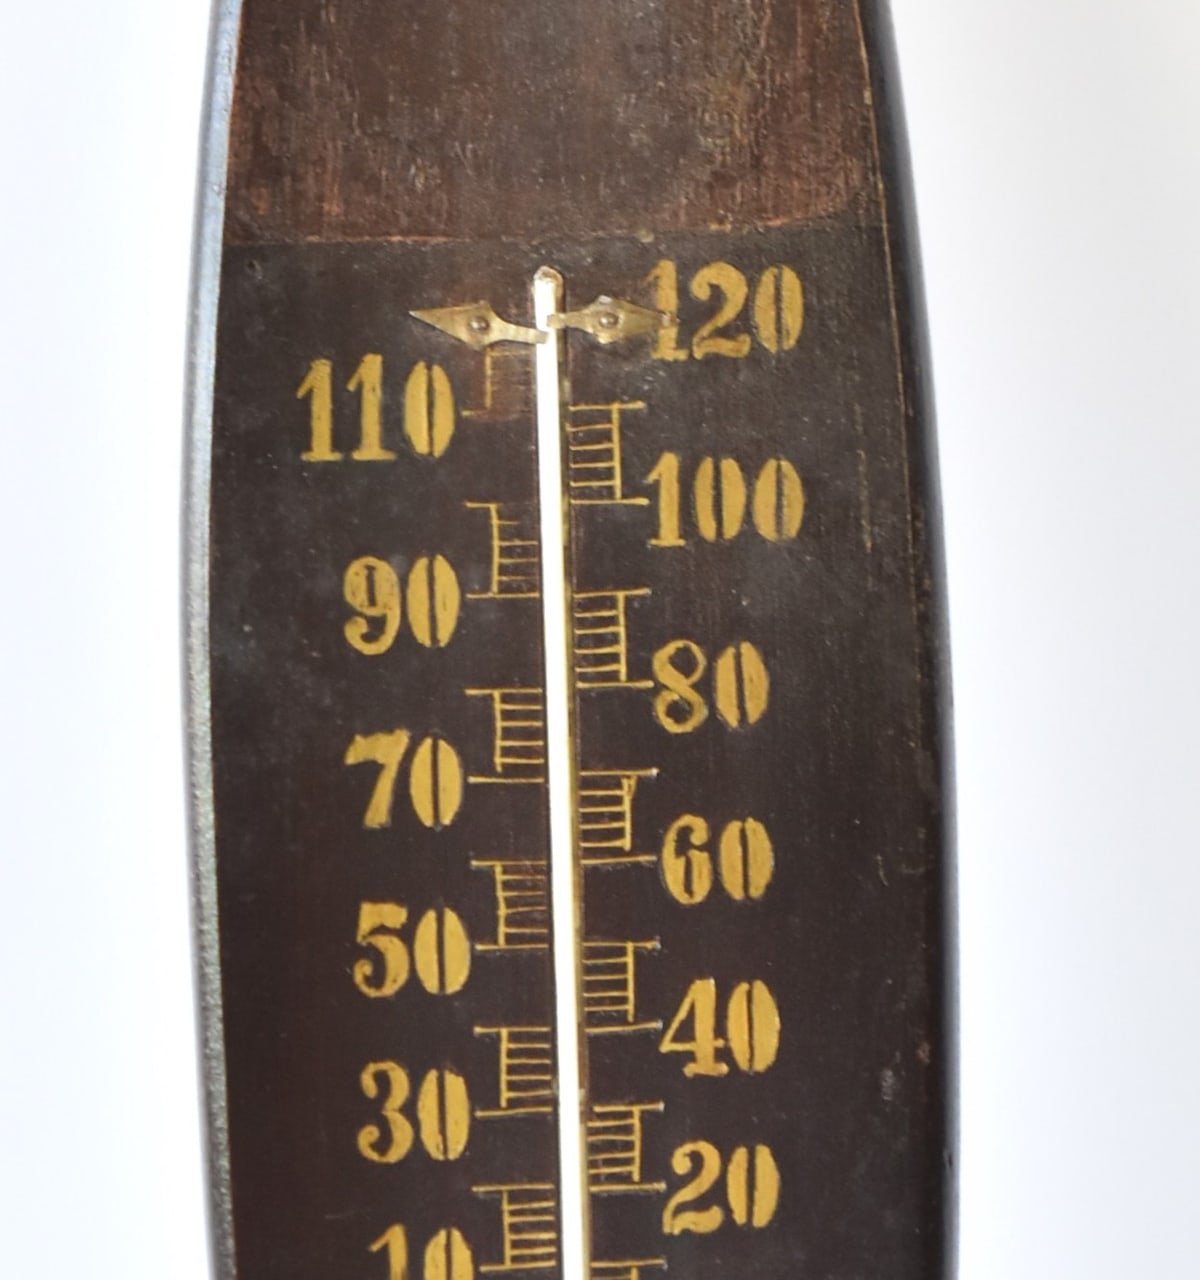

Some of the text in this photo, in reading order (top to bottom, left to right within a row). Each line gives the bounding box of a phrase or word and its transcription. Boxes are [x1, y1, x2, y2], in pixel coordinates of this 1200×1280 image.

[646, 259, 803, 362] 120
[296, 353, 457, 462] 110
[645, 451, 804, 548] 100
[343, 553, 460, 655] 90
[652, 639, 770, 734] 80
[344, 728, 462, 828] 70
[661, 813, 774, 905] 60
[352, 901, 471, 998] 50
[659, 977, 781, 1077] 40
[356, 1060, 471, 1163] 30
[661, 1140, 781, 1235] 20
